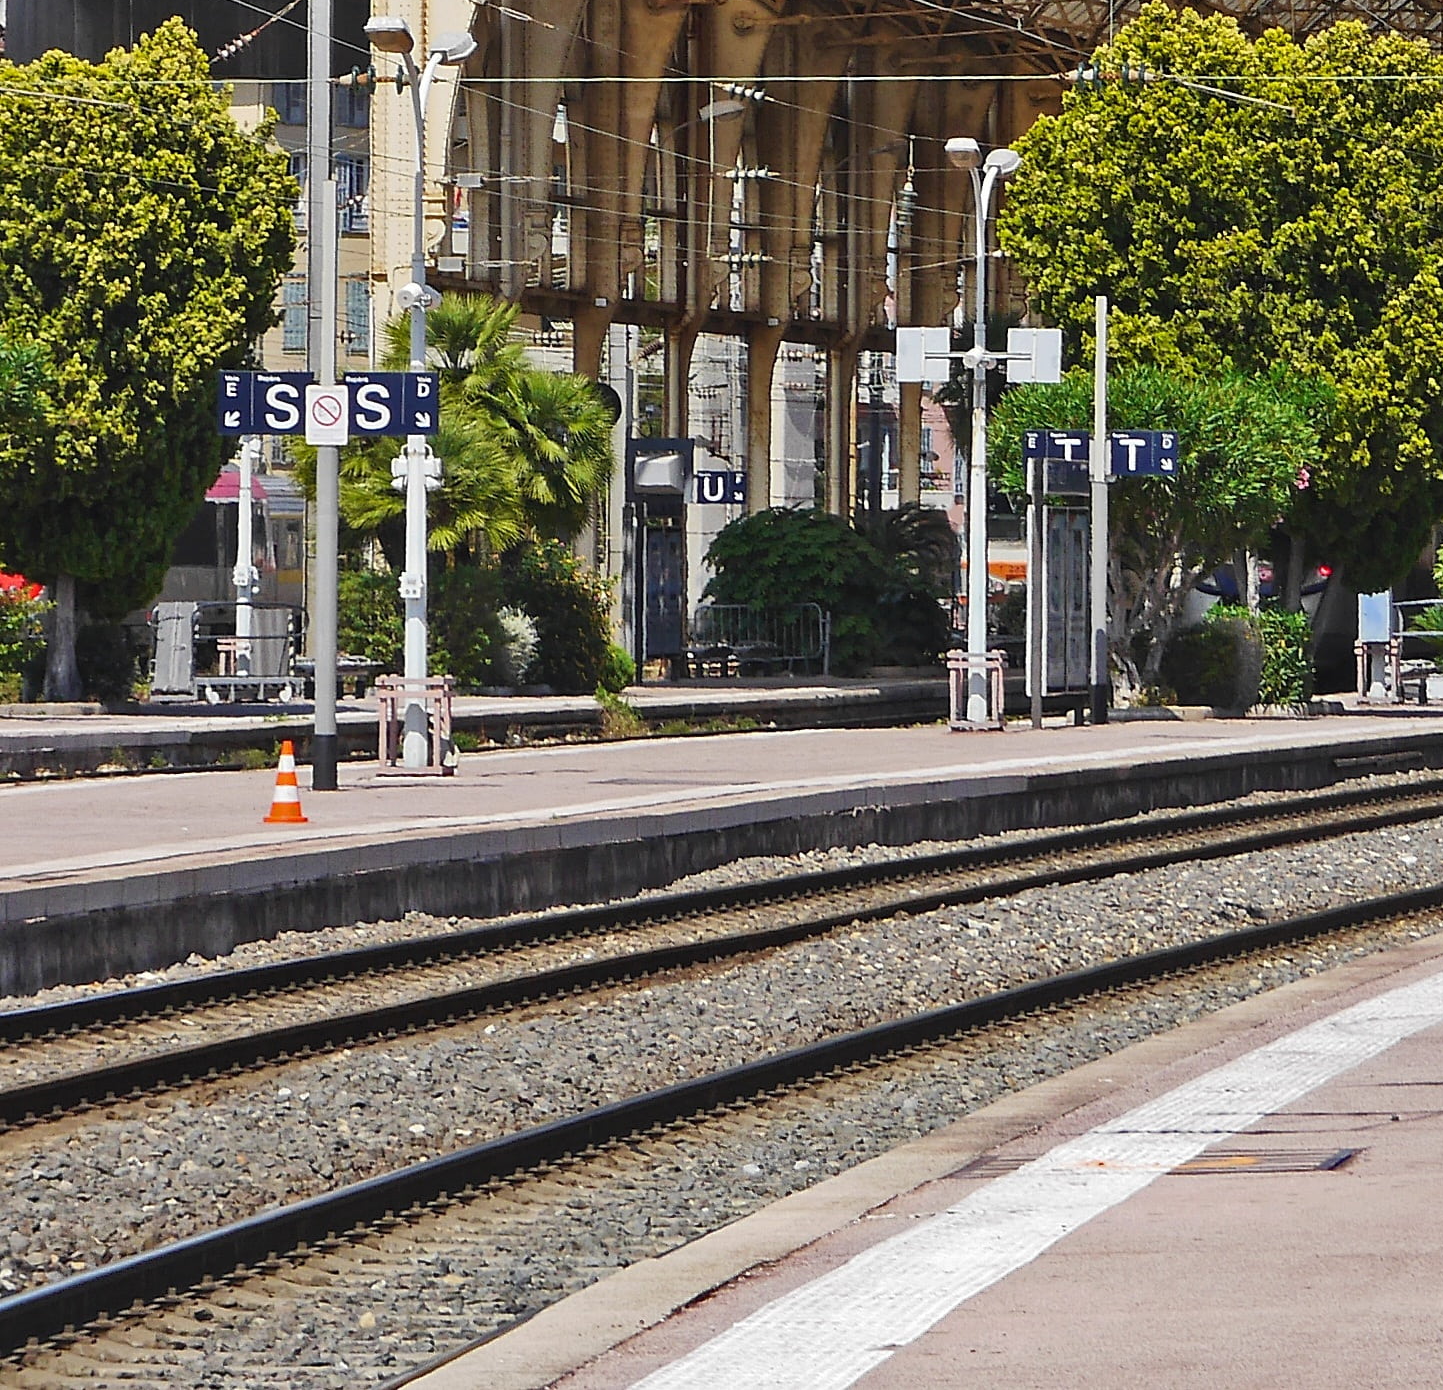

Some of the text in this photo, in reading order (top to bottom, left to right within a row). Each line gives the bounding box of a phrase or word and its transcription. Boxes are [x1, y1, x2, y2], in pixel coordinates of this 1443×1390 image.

[226, 383, 238, 397] E
[417, 383, 430, 398] D
[265, 384, 299, 430] S
[355, 384, 391, 430] S
[1027, 437, 1037, 449] E
[1054, 438, 1082, 461] T
[1119, 438, 1146, 471] T
[703, 476, 725, 502] U
